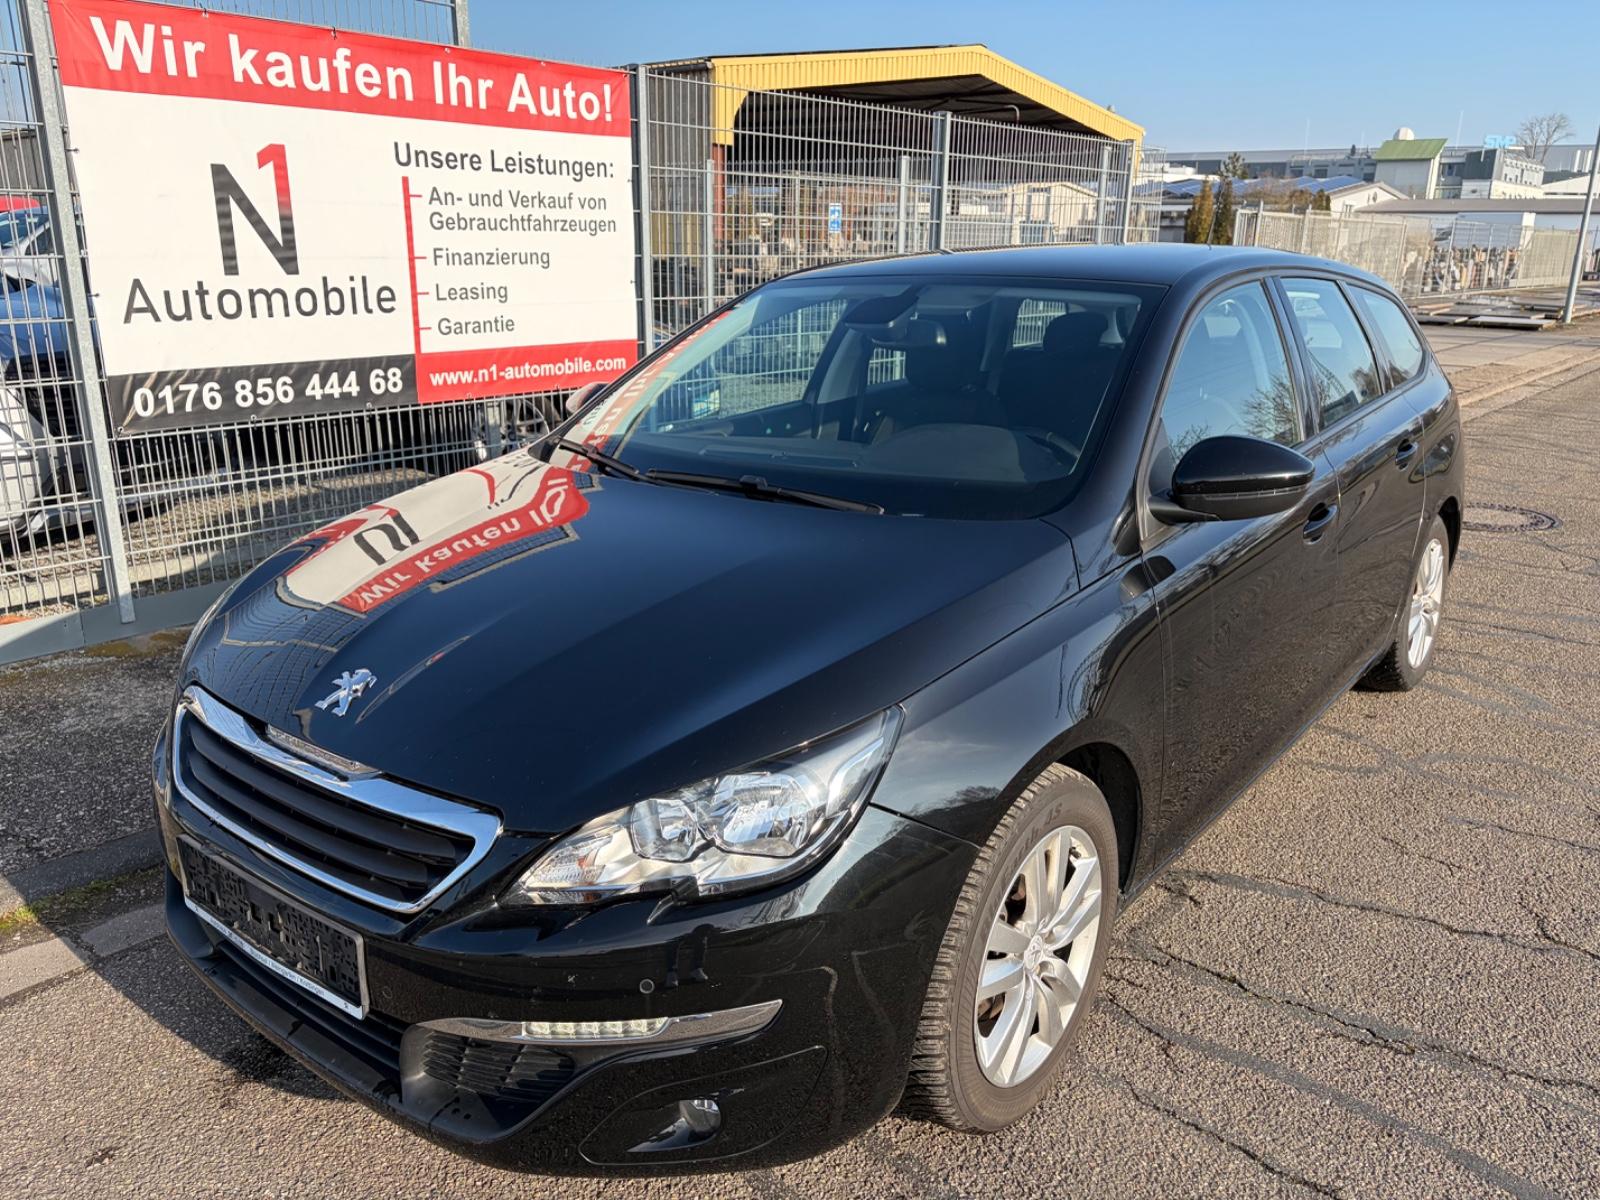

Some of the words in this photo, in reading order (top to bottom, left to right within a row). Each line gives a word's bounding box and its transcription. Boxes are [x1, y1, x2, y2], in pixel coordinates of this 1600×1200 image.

[89, 15, 206, 78] Wir
[228, 33, 415, 101] kaufen
[432, 60, 494, 110] Ihr
[507, 72, 613, 122] Auto!
[393, 141, 482, 171] Unsere
[490, 149, 615, 182] Leistungen:
[210, 143, 299, 276] N1
[428, 186, 463, 206] An-
[468, 189, 503, 208] und
[508, 190, 573, 210] Verkauf
[577, 196, 607, 210] von
[429, 211, 616, 236] Gebrauchtfahrzeugen
[433, 247, 550, 269] Finanzierung
[123, 275, 397, 324] Automobile
[435, 282, 508, 303] Leasing
[437, 315, 515, 336] Garantie
[429, 356, 627, 387] www.n1-automobile.com
[133, 381, 223, 418] 0176
[234, 375, 295, 408] 856
[304, 370, 361, 400] 444
[368, 367, 404, 396] 68
